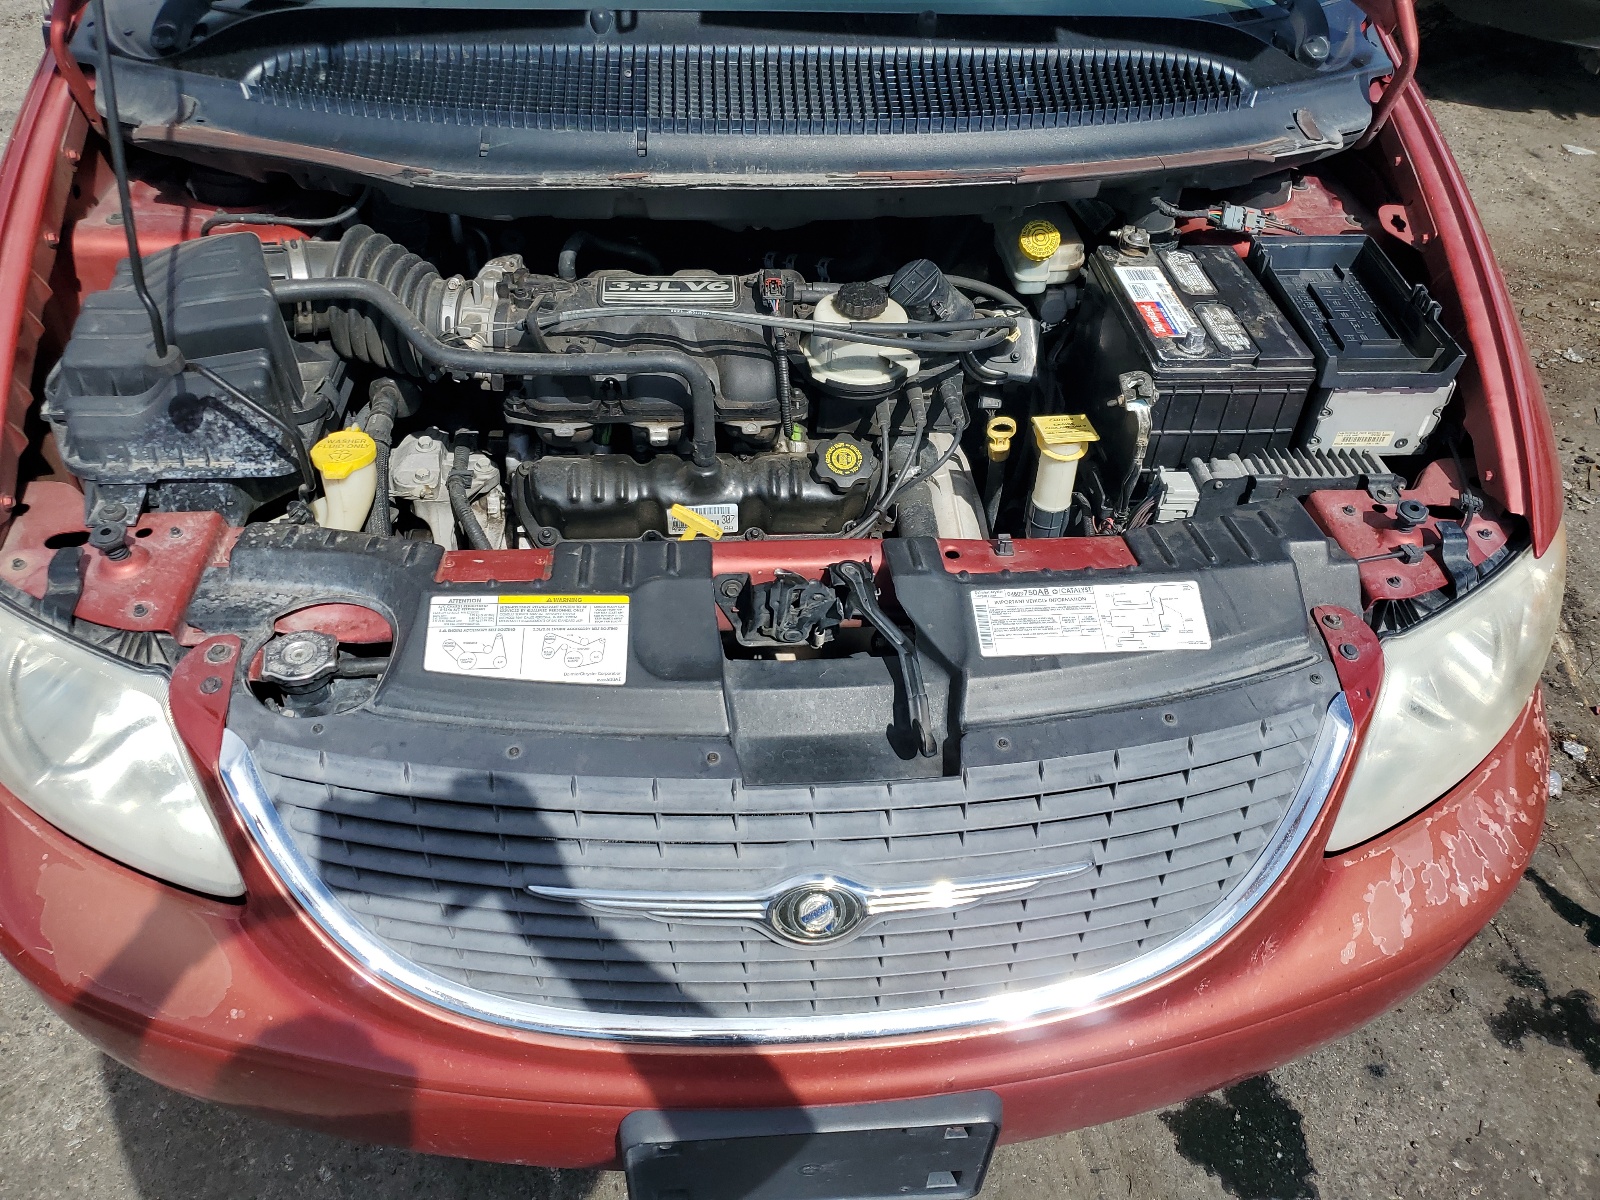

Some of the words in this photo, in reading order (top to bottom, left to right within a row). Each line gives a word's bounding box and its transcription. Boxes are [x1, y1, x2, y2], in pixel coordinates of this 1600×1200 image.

[608, 281, 681, 291] 3.3L
[684, 281, 730, 291] V6
[1140, 304, 1167, 334] Duralast
[1060, 586, 1092, 594] CATALYST
